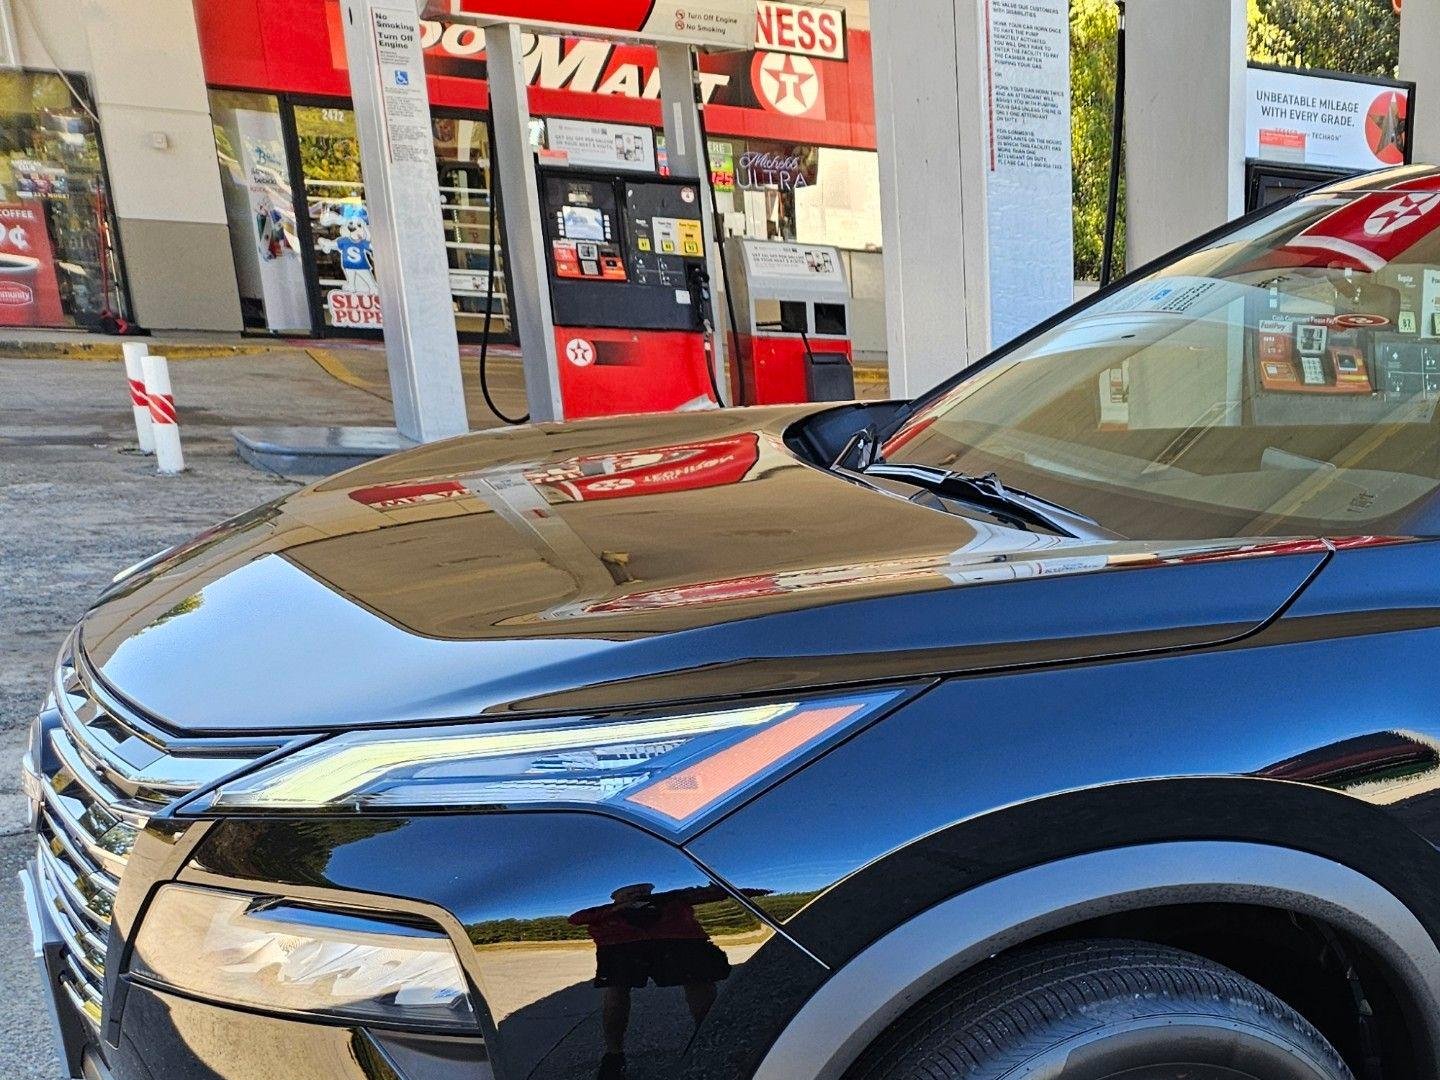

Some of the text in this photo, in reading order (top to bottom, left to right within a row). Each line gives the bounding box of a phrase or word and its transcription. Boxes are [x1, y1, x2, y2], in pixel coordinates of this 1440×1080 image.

[688, 12, 701, 20] Turn
[716, 15, 738, 24] Engine
[377, 21, 414, 32] Smoking
[698, 25, 726, 34] Smoking
[378, 32, 398, 40] Turn
[379, 41, 408, 49] Engine
[1256, 90, 1359, 113] UNBEATABLE MILEAGE
[1261, 105, 1355, 127] WITH EVERY GRADE.
[740, 152, 801, 169] Michelob
[736, 168, 808, 190] ULTRA
[347, 247, 362, 262] S
